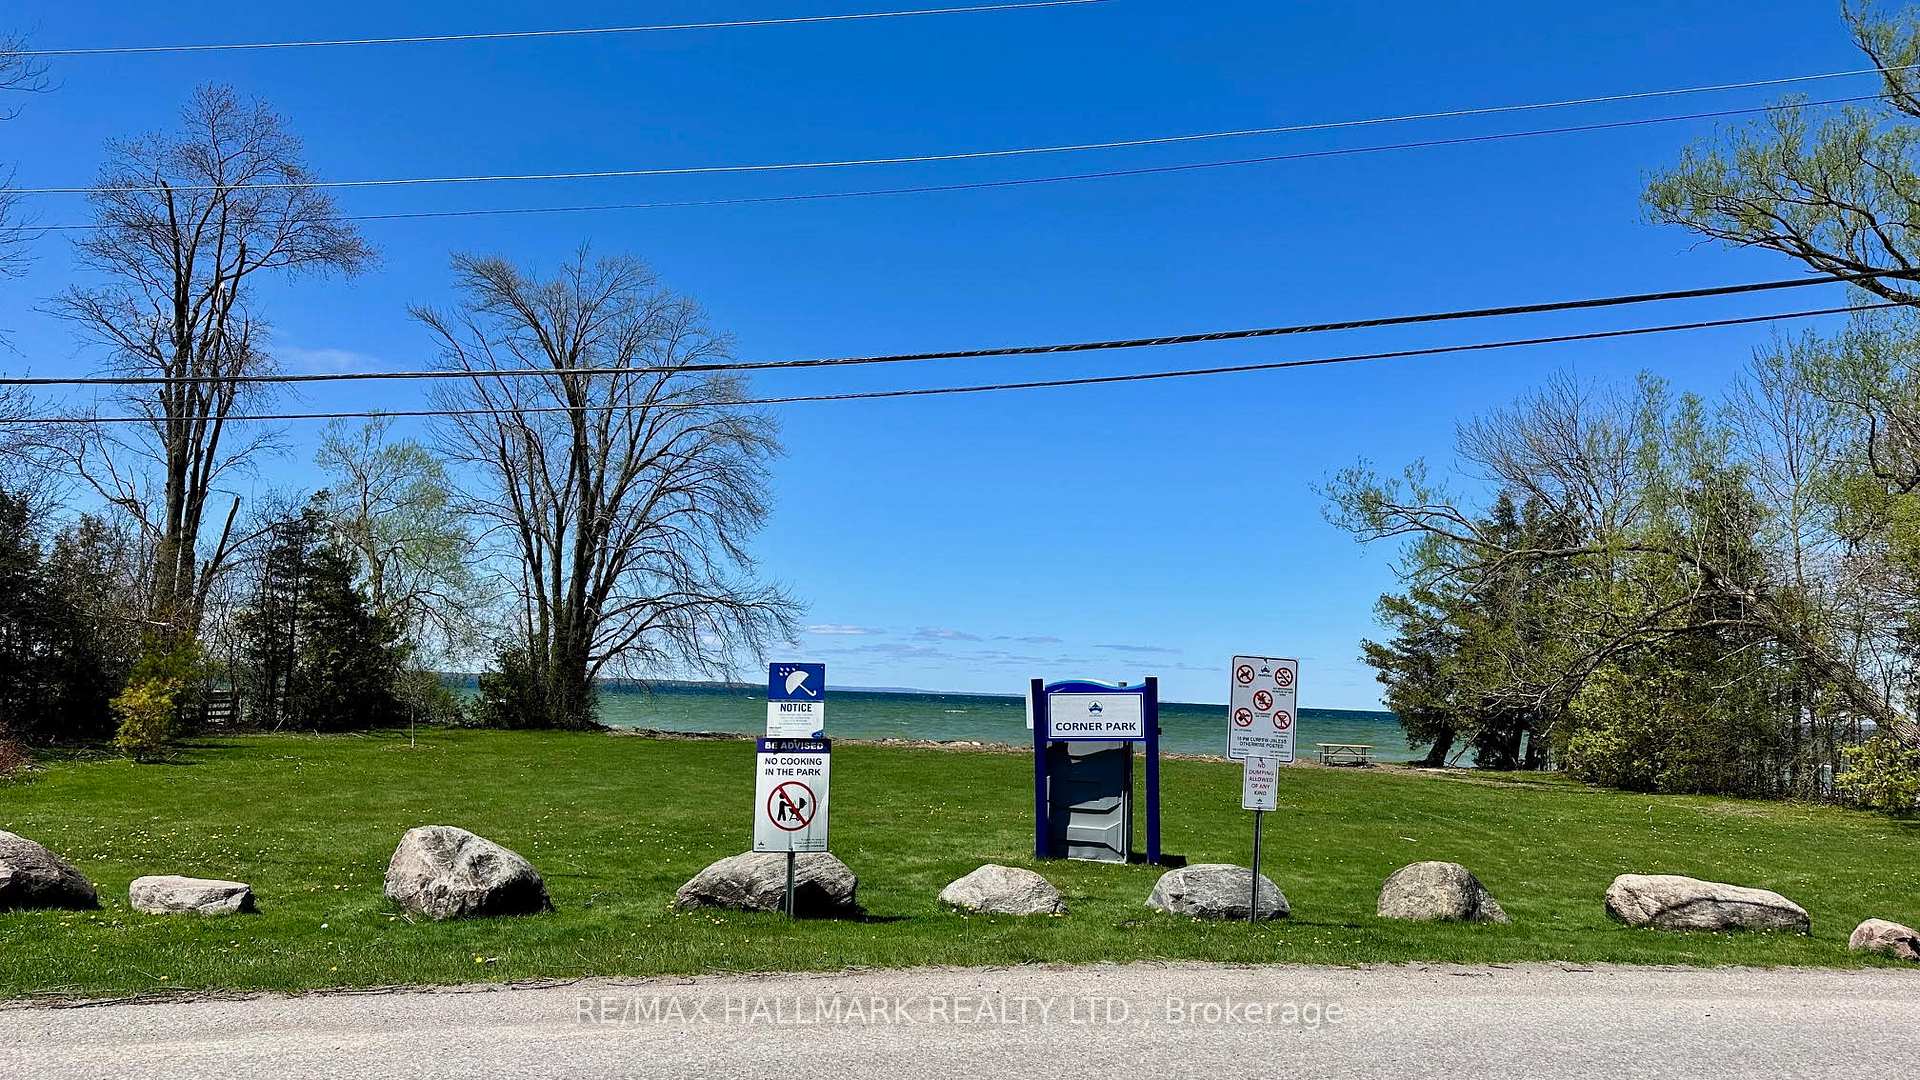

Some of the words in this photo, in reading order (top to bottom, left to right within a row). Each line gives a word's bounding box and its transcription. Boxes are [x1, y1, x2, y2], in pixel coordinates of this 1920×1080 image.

[780, 704, 812, 712] NOTICE
[1055, 722, 1102, 731] CORNER
[1106, 722, 1136, 731] PARK
[765, 741, 778, 750] BE
[780, 741, 824, 750] ADVISED
[765, 757, 778, 765] NO
[780, 757, 823, 766] COOKING
[765, 768, 774, 776] IN
[776, 768, 794, 776] THE
[796, 768, 821, 776] PARK
